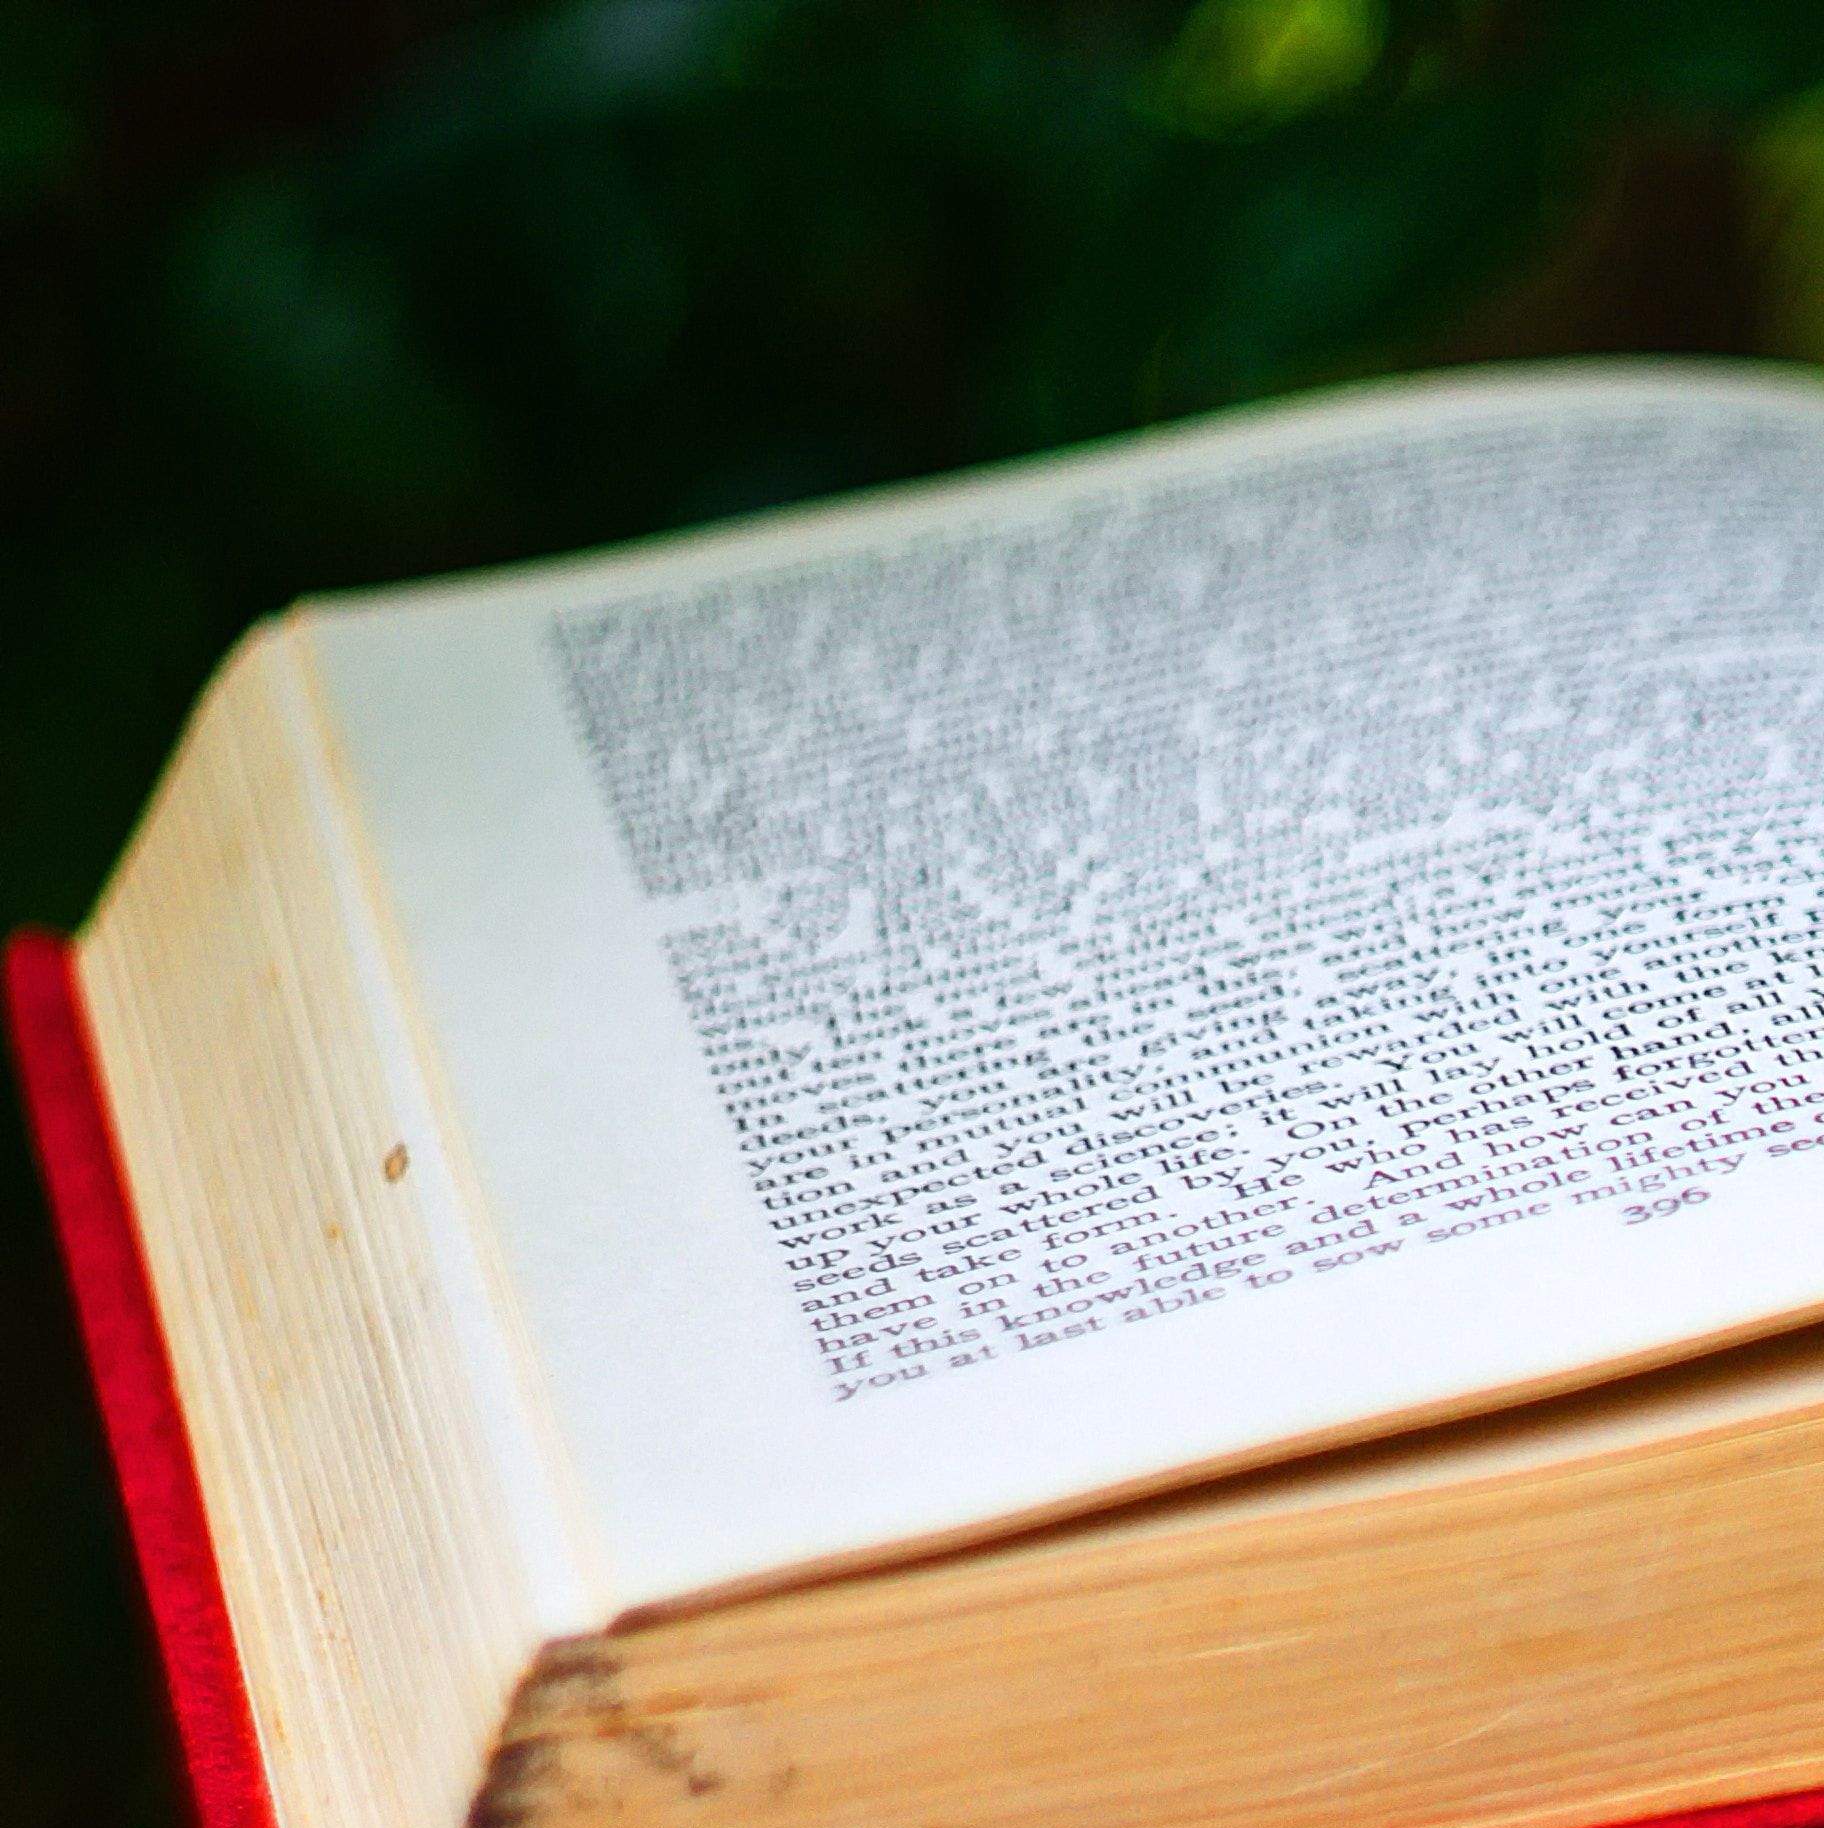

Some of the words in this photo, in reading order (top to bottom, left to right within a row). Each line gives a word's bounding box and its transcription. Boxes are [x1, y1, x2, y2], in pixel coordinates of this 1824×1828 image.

[810, 1293, 935, 1332] them
[958, 1272, 1018, 1296] on
[1039, 1253, 1087, 1273] to
[1110, 1195, 1315, 1255] another.
[1363, 1150, 1465, 1190] And
[1486, 1122, 1588, 1157] how
[1610, 1099, 1697, 1126] can
[1714, 1073, 1810, 1112] you
[819, 1316, 937, 1354] have
[960, 1297, 1009, 1319] in
[1033, 1270, 1110, 1298] the
[1133, 1223, 1284, 1272] future
[1311, 1131, 1653, 1224] determination
[1681, 1102, 1729, 1131] of
[827, 1349, 872, 1376] If
[889, 1328, 980, 1359] this
[1002, 1253, 1265, 1335] knowledge
[1286, 1218, 1379, 1256] and
[1398, 1212, 1427, 1226] a
[1445, 1169, 1590, 1211] whole
[1607, 1120, 1795, 1172] lifetime
[835, 1364, 927, 1402] you
[949, 1345, 992, 1368] at
[1016, 1316, 1103, 1350] last
[1123, 1276, 1224, 1323] able
[1245, 1269, 1292, 1289] to
[1313, 1239, 1403, 1273] sow
[1427, 1202, 1550, 1243] some
[1571, 1153, 1744, 1204] mighty
[1621, 1184, 1713, 1227] 396
